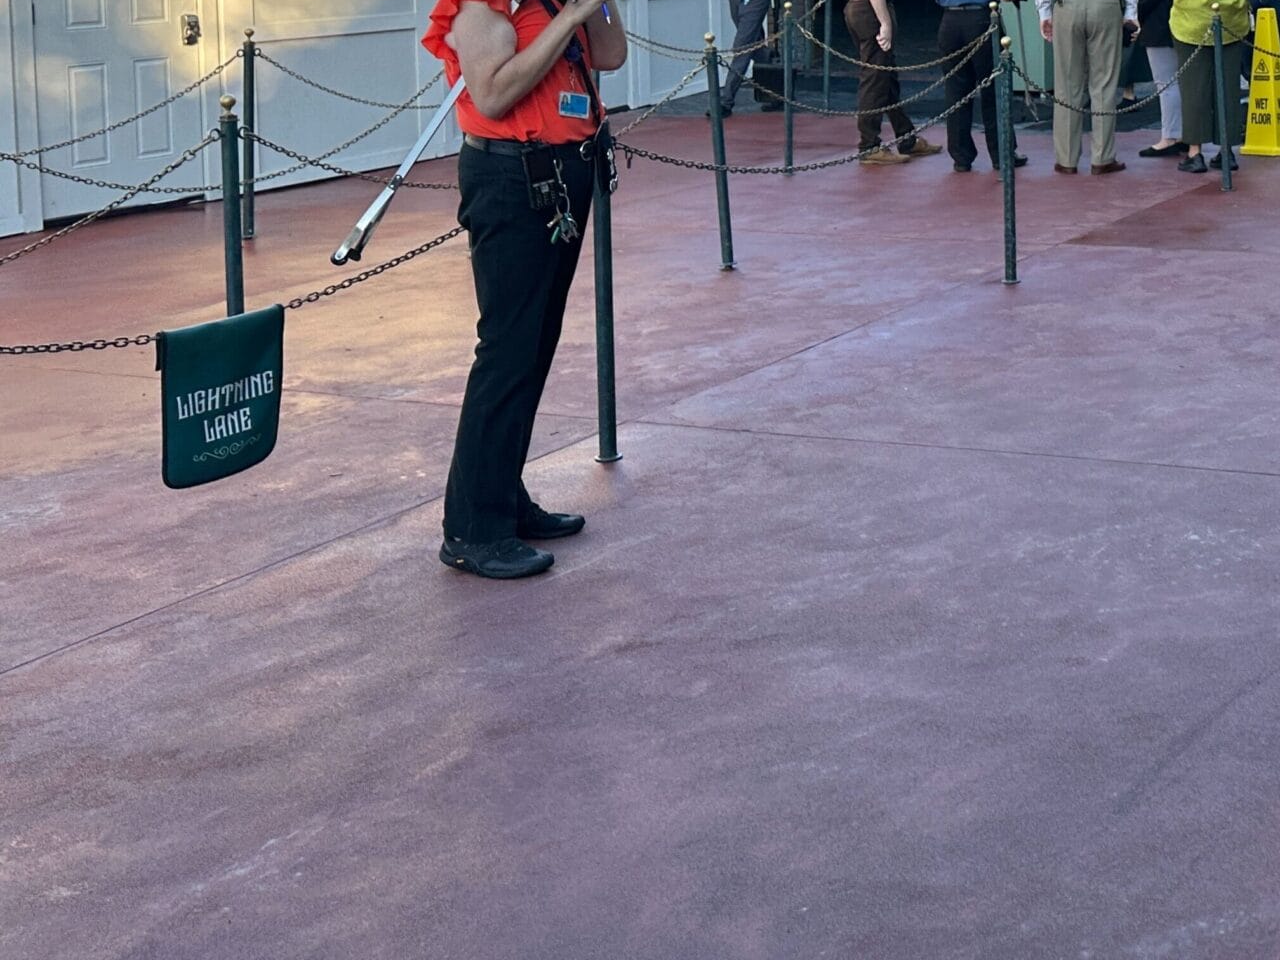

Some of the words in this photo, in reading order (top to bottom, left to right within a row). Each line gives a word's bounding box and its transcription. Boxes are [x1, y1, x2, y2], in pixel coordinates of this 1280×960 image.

[1254, 98, 1268, 110] WET
[1251, 113, 1272, 125] FLOOR
[176, 370, 274, 421] LIGHTNING
[203, 406, 252, 444] LANE
